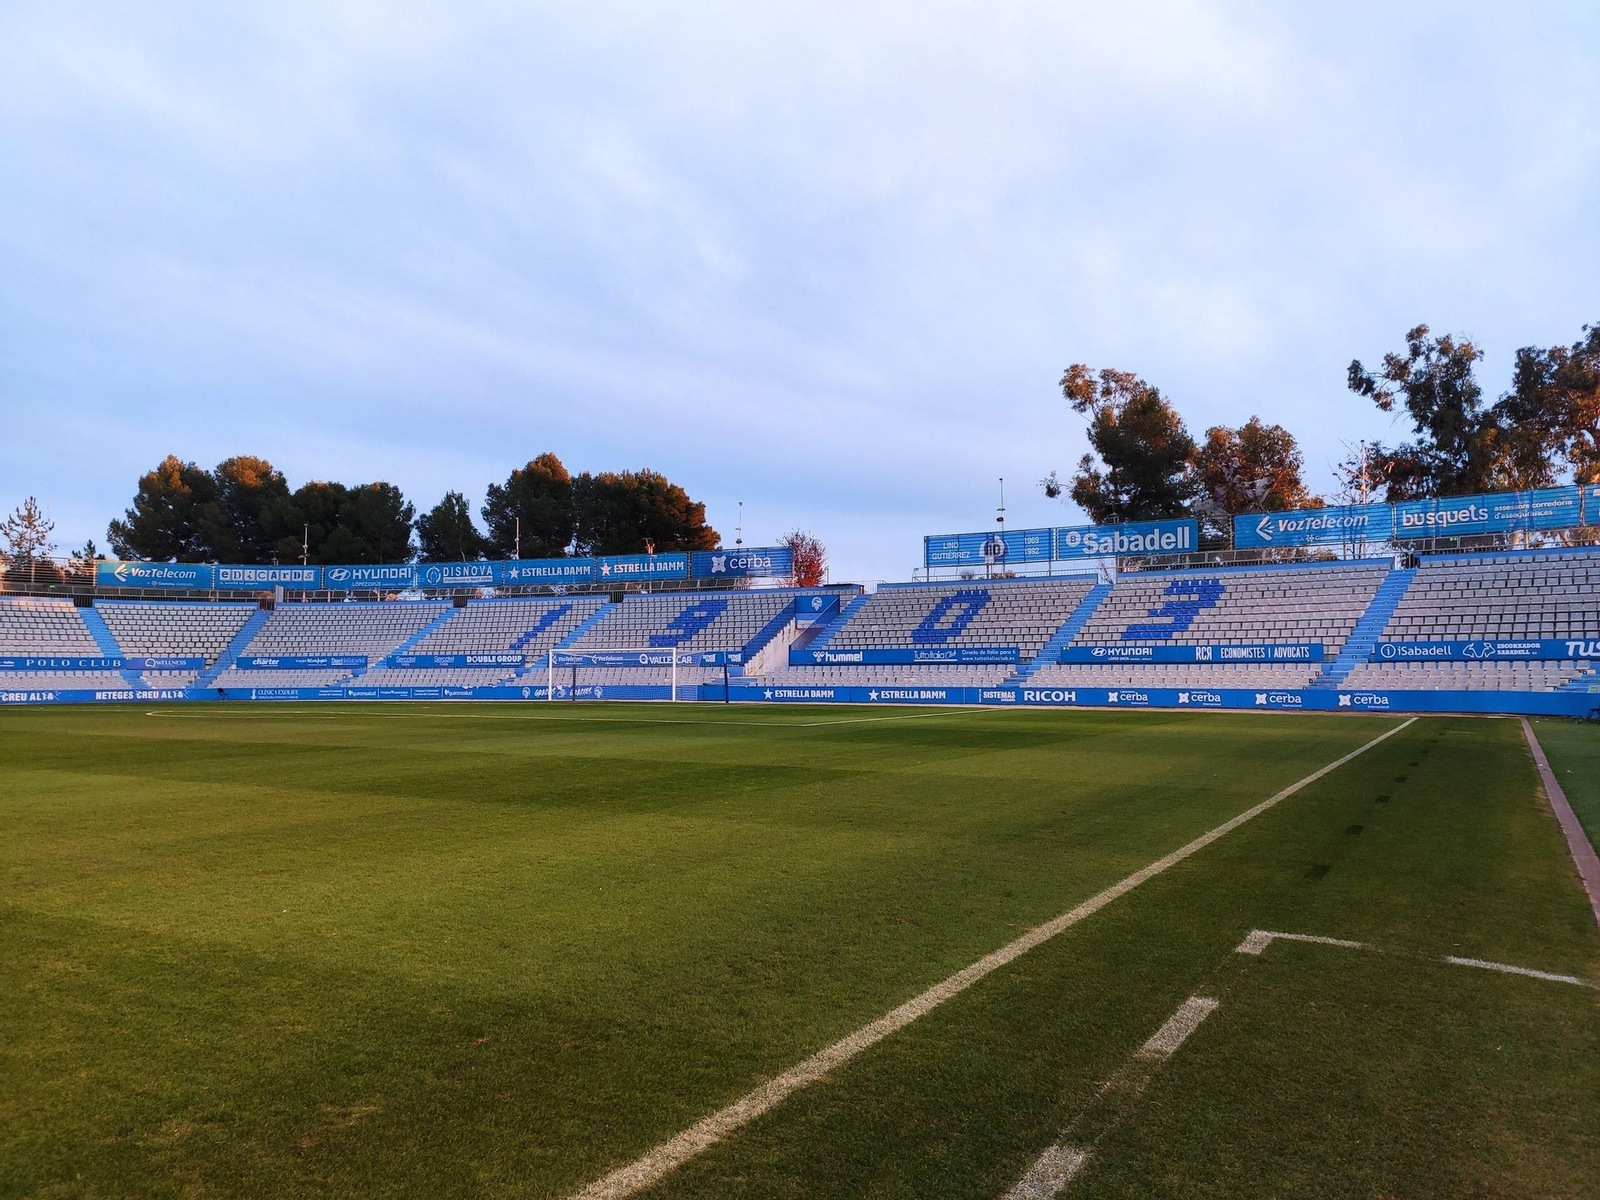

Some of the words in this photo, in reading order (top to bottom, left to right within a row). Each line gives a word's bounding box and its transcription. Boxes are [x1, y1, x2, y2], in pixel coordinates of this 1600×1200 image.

[1402, 504, 1488, 527] busquets
[1278, 515, 1368, 531] VozTelecom
[1082, 527, 1190, 554] Sabadell
[932, 551, 971, 560] GUTIÉRREZ
[730, 555, 772, 568] cerba
[443, 566, 493, 576] DISNOVA
[522, 568, 562, 576] ESTRELLA
[564, 566, 590, 576] DAMM
[614, 563, 656, 573] ESTRELLA
[657, 562, 684, 571] DAMM
[131, 568, 196, 579] VozTelecom
[352, 569, 412, 580] HYUNDAI
[1108, 648, 1152, 656] HYUNDAI
[1220, 646, 1266, 659] ECONOMISTES
[1274, 646, 1310, 658] ADVOCATS
[1398, 645, 1452, 656] iSabadell
[825, 652, 862, 662] hummel
[2, 692, 26, 702] CREU
[96, 692, 134, 700] NETEGES
[136, 691, 158, 699] CREU
[774, 690, 810, 698] ESTRELLA
[811, 690, 834, 698] DAMM
[880, 690, 919, 699] ESTRELLA
[920, 690, 946, 699] DAMM
[983, 691, 1016, 699] SISTEMAS
[1024, 690, 1076, 702] RICOH
[1120, 692, 1148, 701] cerba
[1191, 693, 1221, 702] cerba
[1269, 694, 1302, 703] cerba
[1354, 694, 1389, 704] cerba
